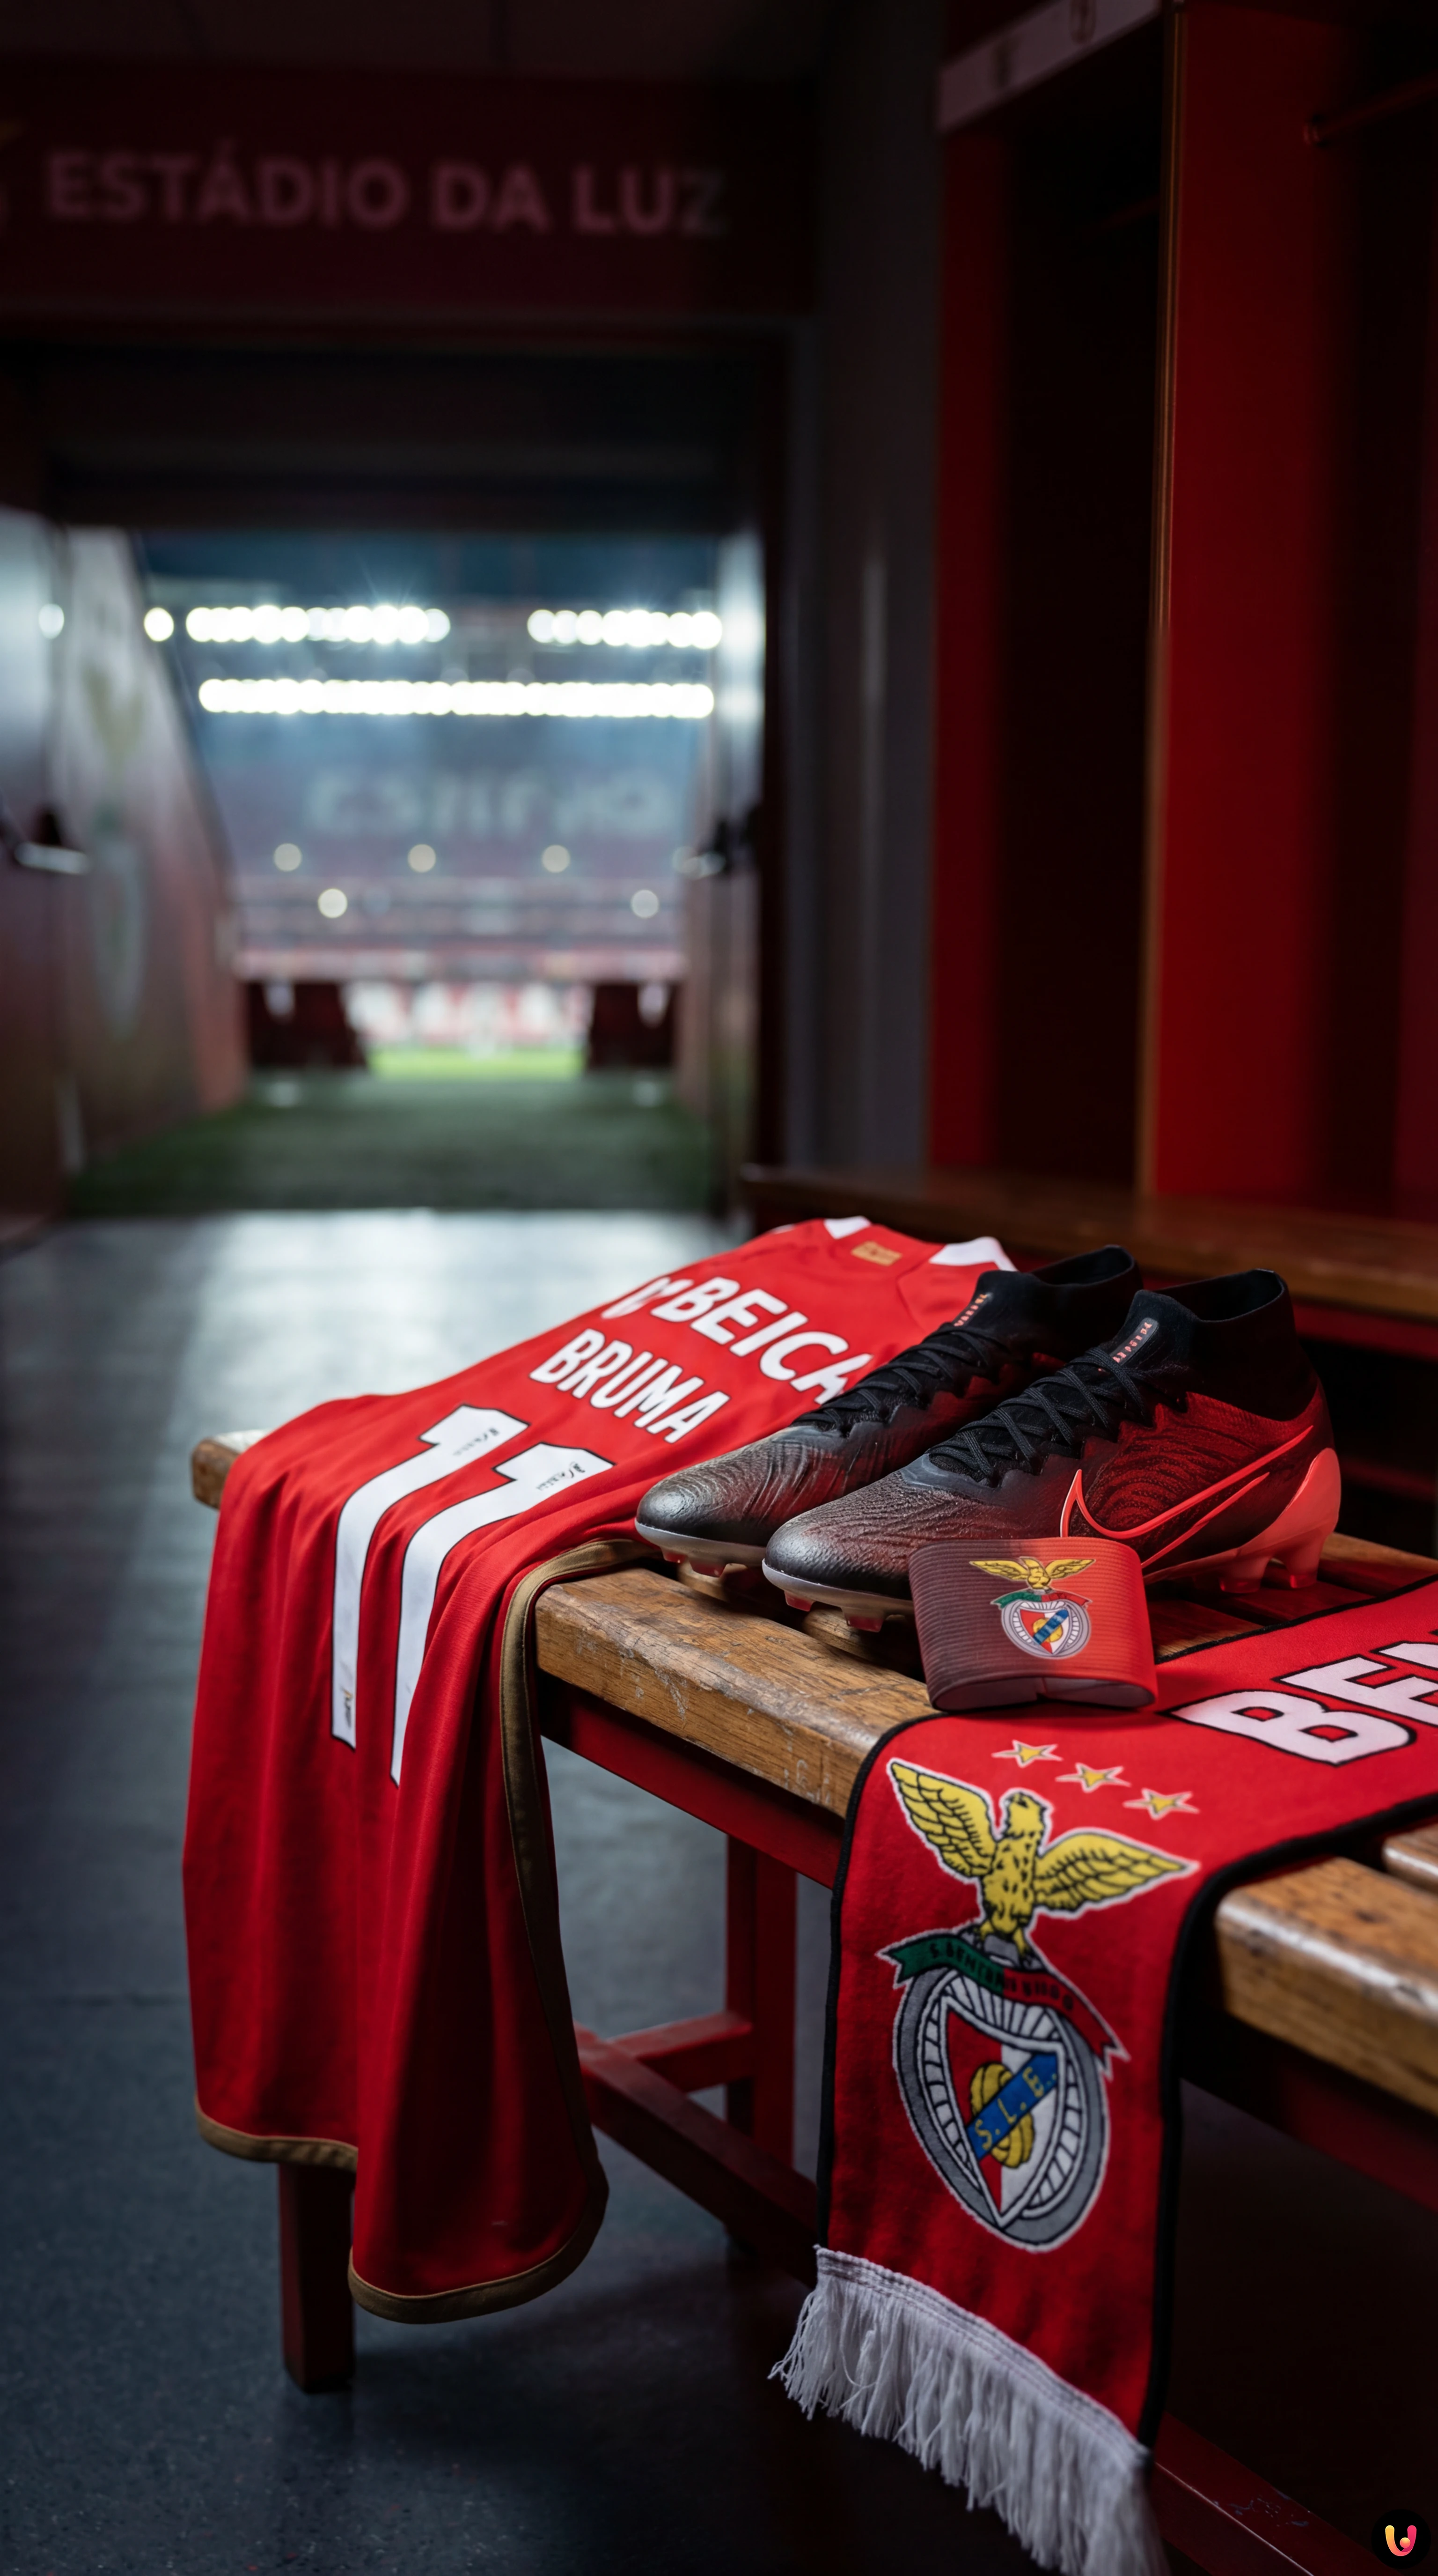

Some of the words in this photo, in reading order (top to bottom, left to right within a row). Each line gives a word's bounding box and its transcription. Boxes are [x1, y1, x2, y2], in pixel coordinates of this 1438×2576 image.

[44, 139, 409, 230] ESTÁDIO
[432, 162, 550, 234] DA
[574, 164, 728, 237] LUZ
[529, 1328, 731, 1444] BRUMA
[331, 1404, 617, 1788] 11
